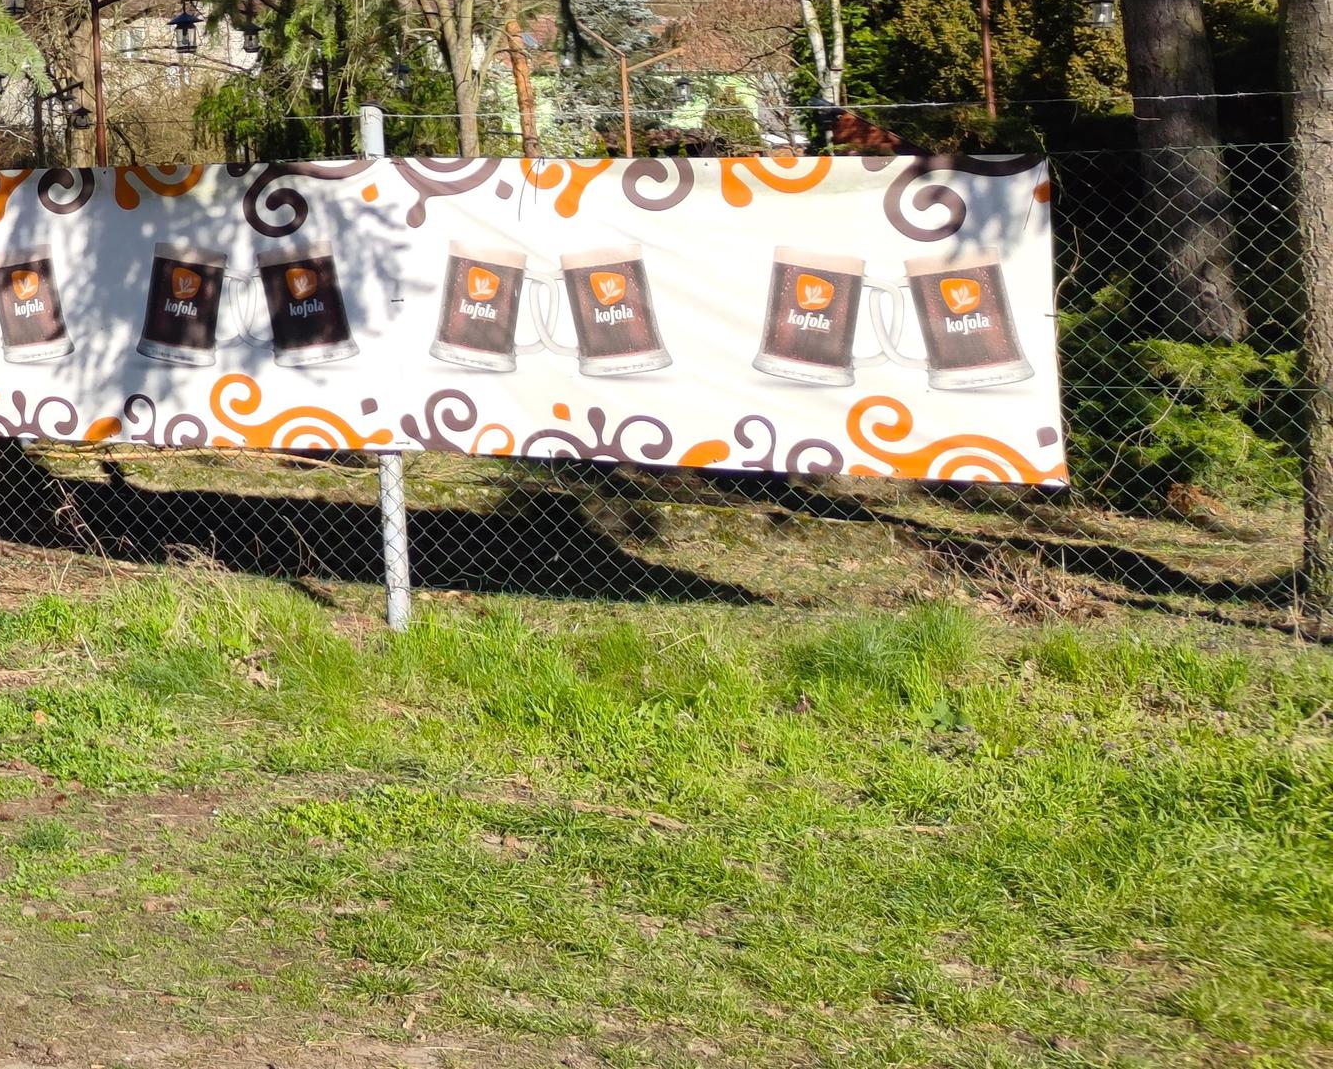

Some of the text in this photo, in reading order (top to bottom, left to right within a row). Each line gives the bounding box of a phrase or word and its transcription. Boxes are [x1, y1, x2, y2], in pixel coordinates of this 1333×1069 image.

[14, 299, 45, 318] kofola
[165, 299, 198, 317] kofola
[289, 298, 325, 318] kofola
[459, 299, 496, 320] kofola
[595, 304, 634, 325] kofola
[787, 309, 831, 330] kofola
[945, 313, 990, 335] kofola
